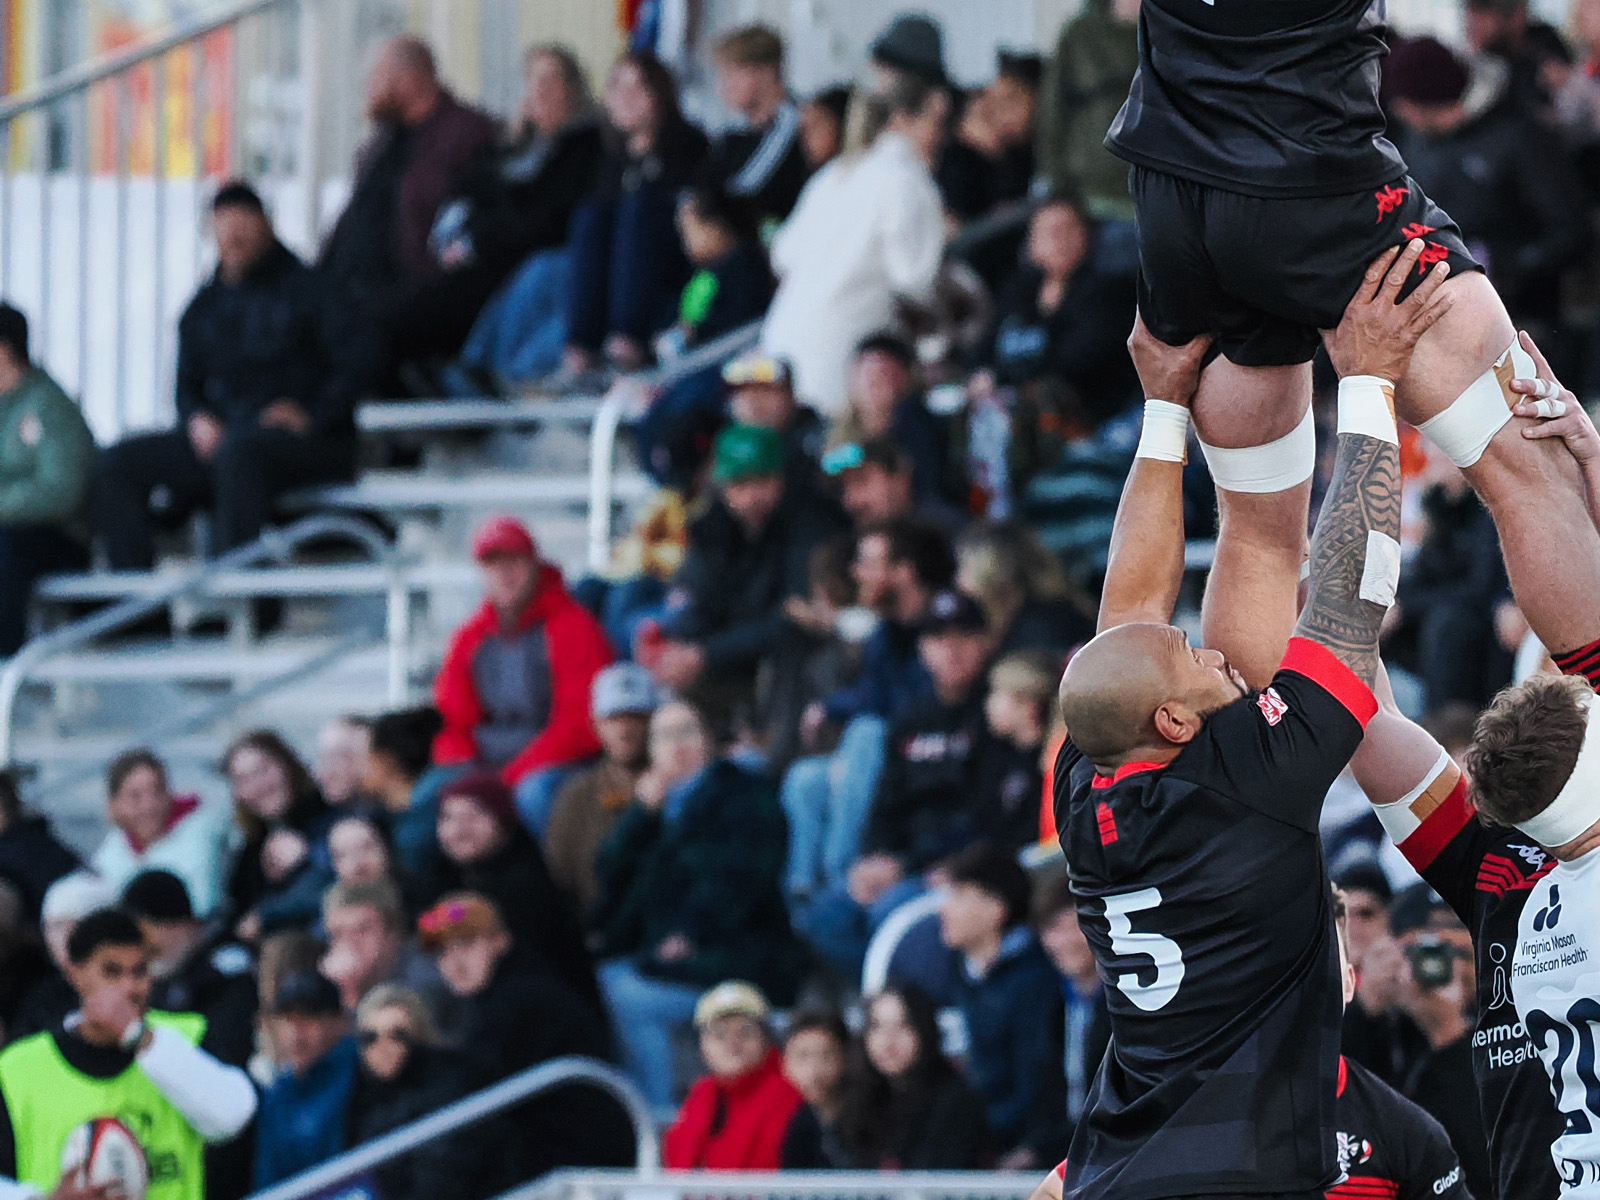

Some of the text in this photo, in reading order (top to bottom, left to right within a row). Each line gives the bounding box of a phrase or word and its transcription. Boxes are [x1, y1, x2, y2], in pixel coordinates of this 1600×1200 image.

[1099, 886, 1186, 1012] 5
[1520, 933, 1577, 959] Virginia Mason
[1512, 947, 1588, 977] Franciscan Health
